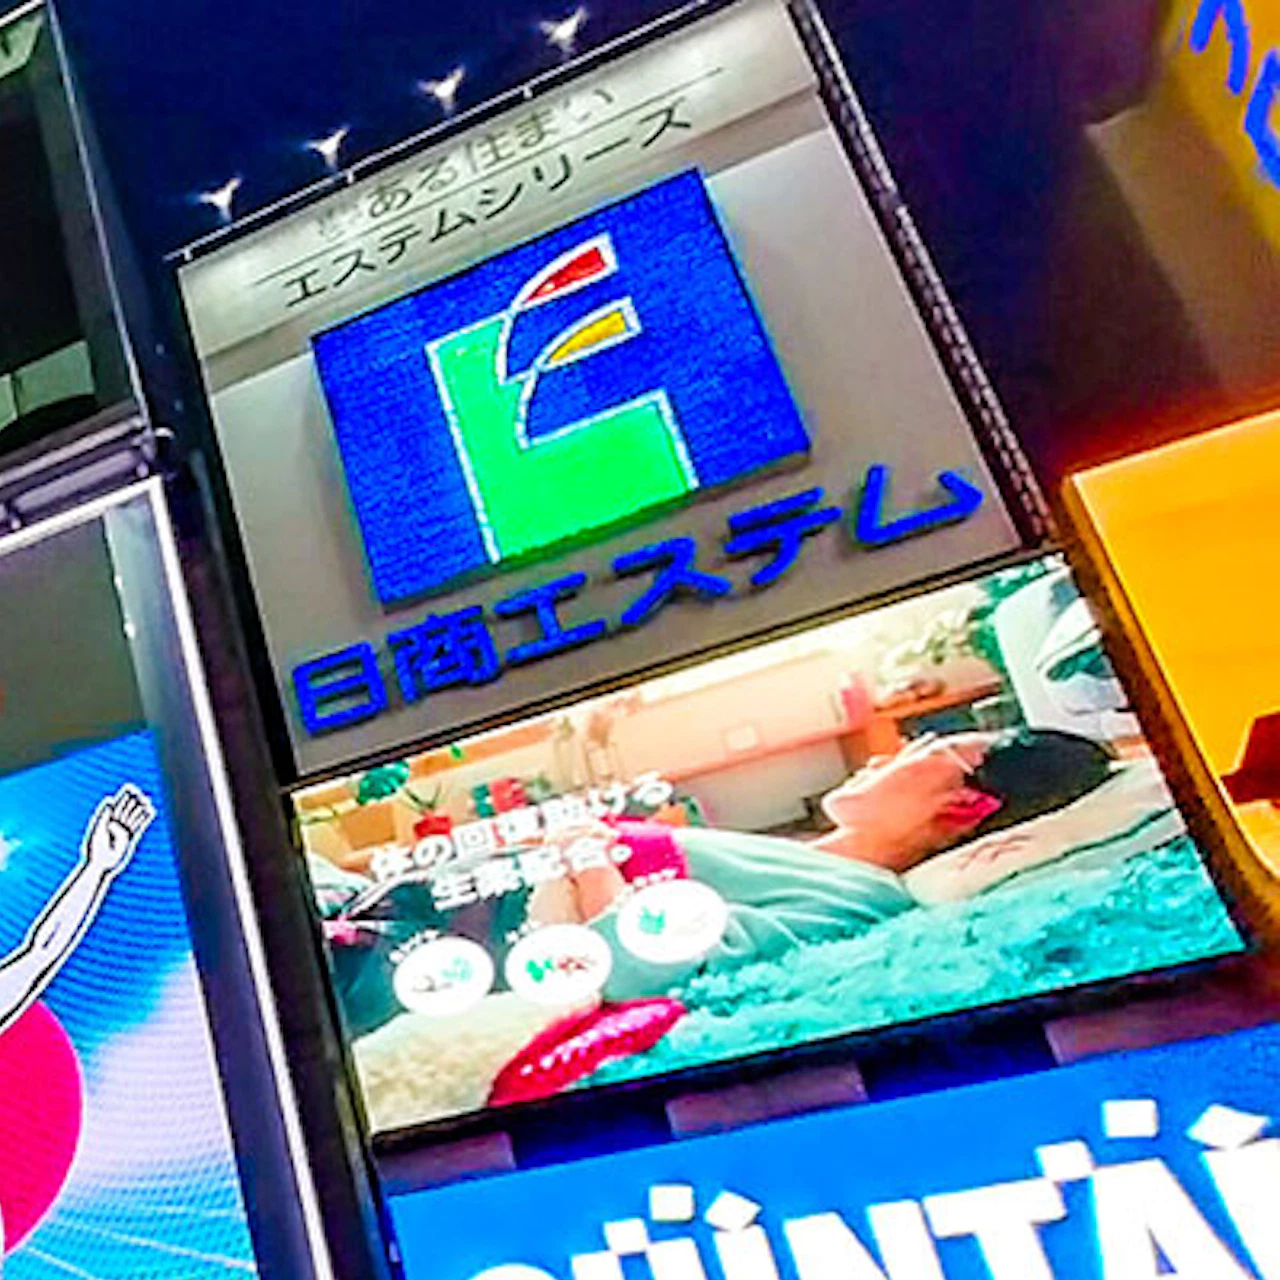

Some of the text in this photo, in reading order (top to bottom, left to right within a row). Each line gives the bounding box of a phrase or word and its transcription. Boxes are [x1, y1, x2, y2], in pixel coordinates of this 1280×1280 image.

[281, 100, 691, 308] エステムシリーズ
[317, 88, 614, 240] ある住まい
[290, 464, 985, 736] 日商エステム
